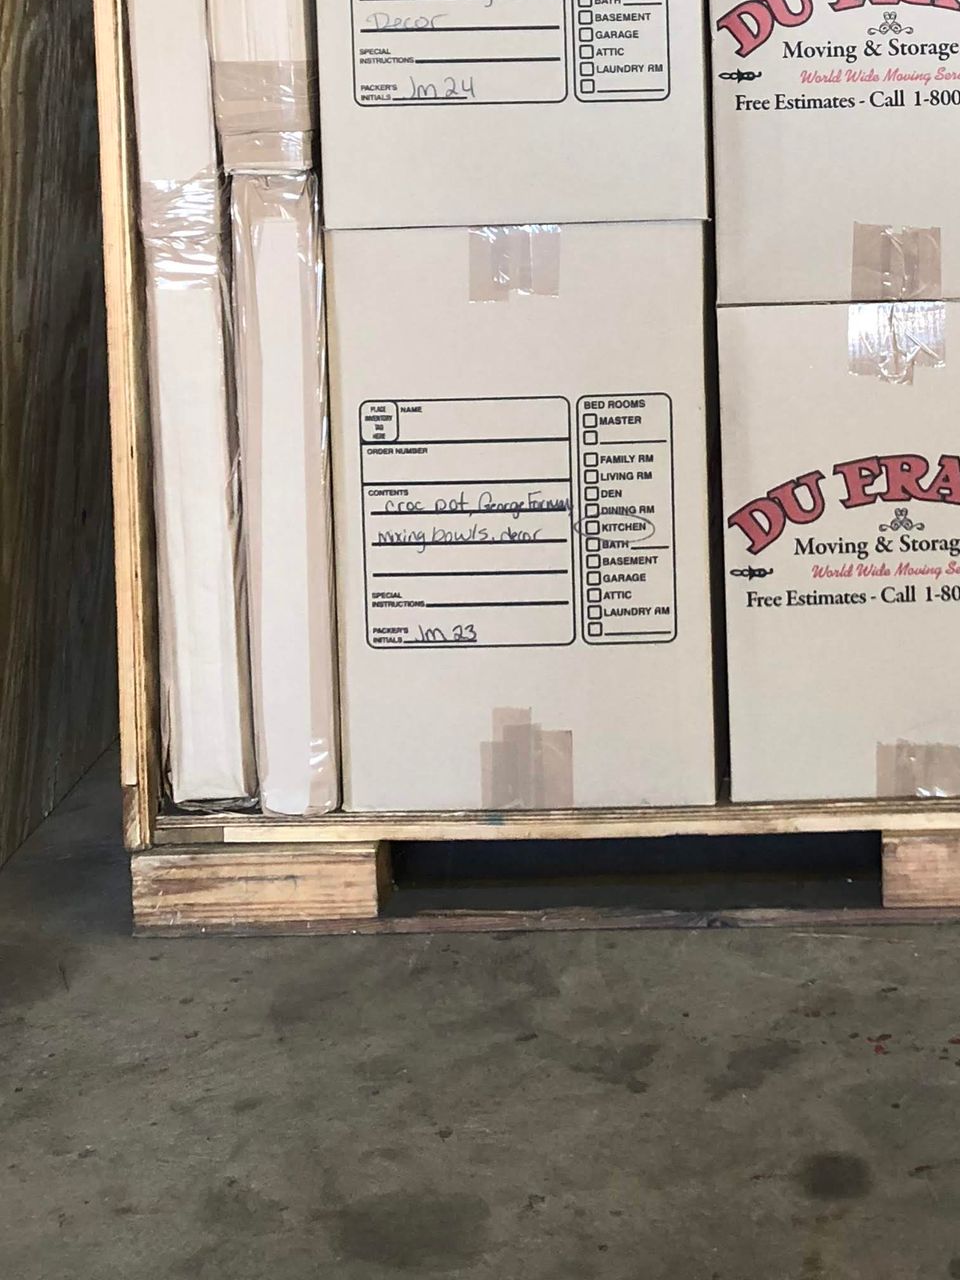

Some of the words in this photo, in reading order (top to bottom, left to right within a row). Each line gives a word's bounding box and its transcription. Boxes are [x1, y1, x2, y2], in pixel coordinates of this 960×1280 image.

[595, 13, 651, 22] BASEMENT
[595, 30, 639, 39] GARAGE
[596, 48, 624, 56] ATTIC
[782, 40, 857, 63] Moving
[864, 40, 881, 56] &
[888, 38, 959, 61] Storage
[596, 64, 644, 73] LAUNDRY
[648, 64, 663, 72] RM
[800, 69, 842, 84] World
[845, 69, 879, 83] Wide
[882, 68, 931, 85] Moving
[445, 76, 476, 98] 24
[735, 94, 770, 110] Free
[775, 93, 855, 110] Estimates
[869, 90, 904, 107] Call
[584, 401, 604, 409] BED
[608, 400, 645, 408] ROOMS
[600, 416, 641, 425] MASTER
[600, 455, 635, 464] FAMILY
[638, 454, 653, 463] RM
[601, 472, 633, 481] LIVING
[636, 471, 652, 480] RM
[601, 489, 622, 498] DEN
[478, 491, 524, 519] George
[602, 506, 636, 515] DINING
[639, 505, 654, 514] RM
[728, 470, 826, 555] DU
[602, 523, 646, 532] KITCHEN
[602, 540, 629, 549] BATH
[794, 537, 869, 559] Moving
[875, 536, 893, 553] &
[603, 556, 658, 565] BASEMENT
[811, 564, 852, 579] World
[856, 564, 891, 577] Wide
[894, 563, 942, 579] Moving
[603, 573, 646, 582] GARAGE
[603, 591, 632, 599] ATTIC
[746, 591, 782, 608] Free
[786, 589, 867, 606] Estimates
[881, 586, 916, 604] Call
[604, 607, 651, 616] LAUNDRY
[655, 606, 669, 615] RM
[452, 624, 476, 641] 23
